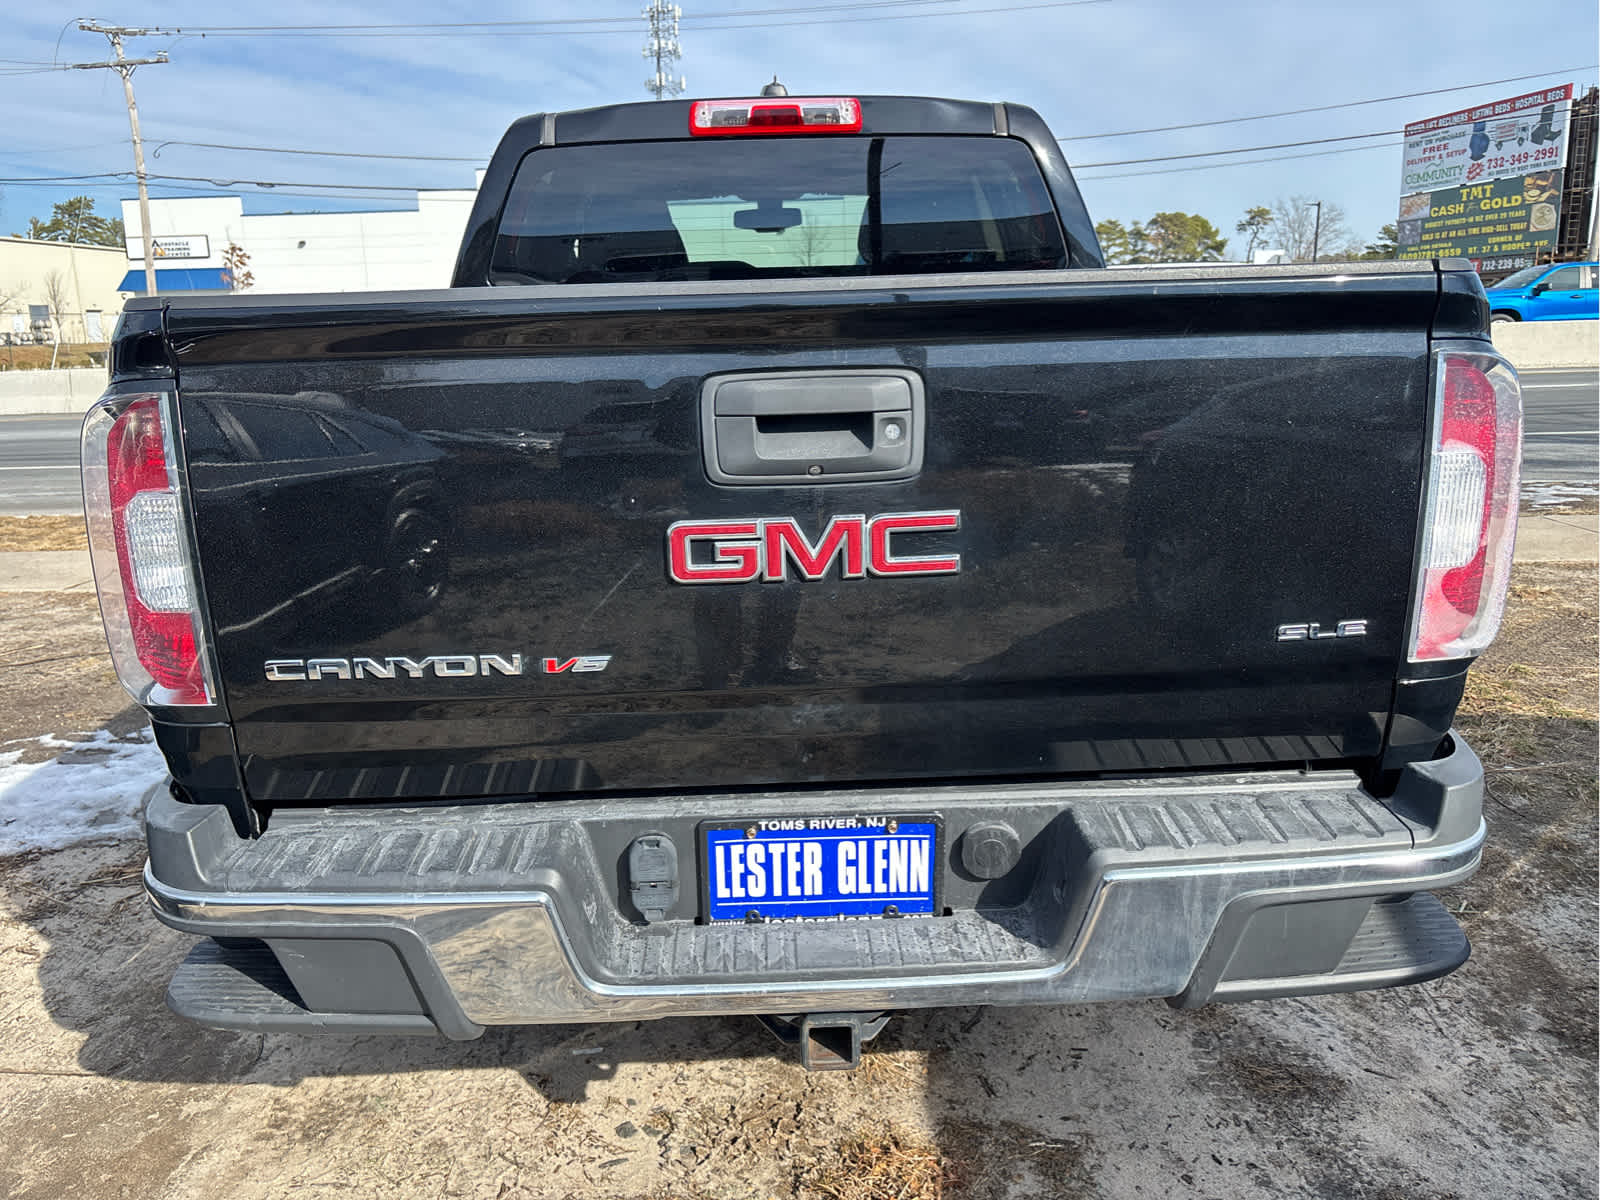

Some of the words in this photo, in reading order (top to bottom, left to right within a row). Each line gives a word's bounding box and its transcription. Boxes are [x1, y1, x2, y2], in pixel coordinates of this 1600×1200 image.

[1495, 102, 1511, 114] BEDS
[1515, 94, 1545, 110] HOSPITAL
[1547, 89, 1565, 101] BEDS
[1406, 155, 1436, 167] DELIVERY
[1445, 148, 1467, 159] SETUP
[1422, 142, 1449, 155] FREE
[1487, 146, 1559, 169] 732-349-2991
[1404, 164, 1465, 185] COMMUNITY
[1460, 184, 1494, 201] TMT
[1430, 203, 1465, 218] CASH
[1480, 195, 1522, 210] GOLD
[1509, 210, 1526, 218] YEARS
[1481, 245, 1491, 253] 37
[1501, 241, 1531, 251] HOOPER
[667, 509, 960, 584] GMC
[1278, 619, 1368, 641] SLE
[264, 653, 523, 681] CANYON
[542, 655, 612, 674] V6
[758, 819, 805, 832] TOMS
[809, 818, 862, 830] RIVER,
[866, 817, 887, 828] NJ
[715, 841, 823, 899] LESTER
[837, 839, 930, 895] GLENN
